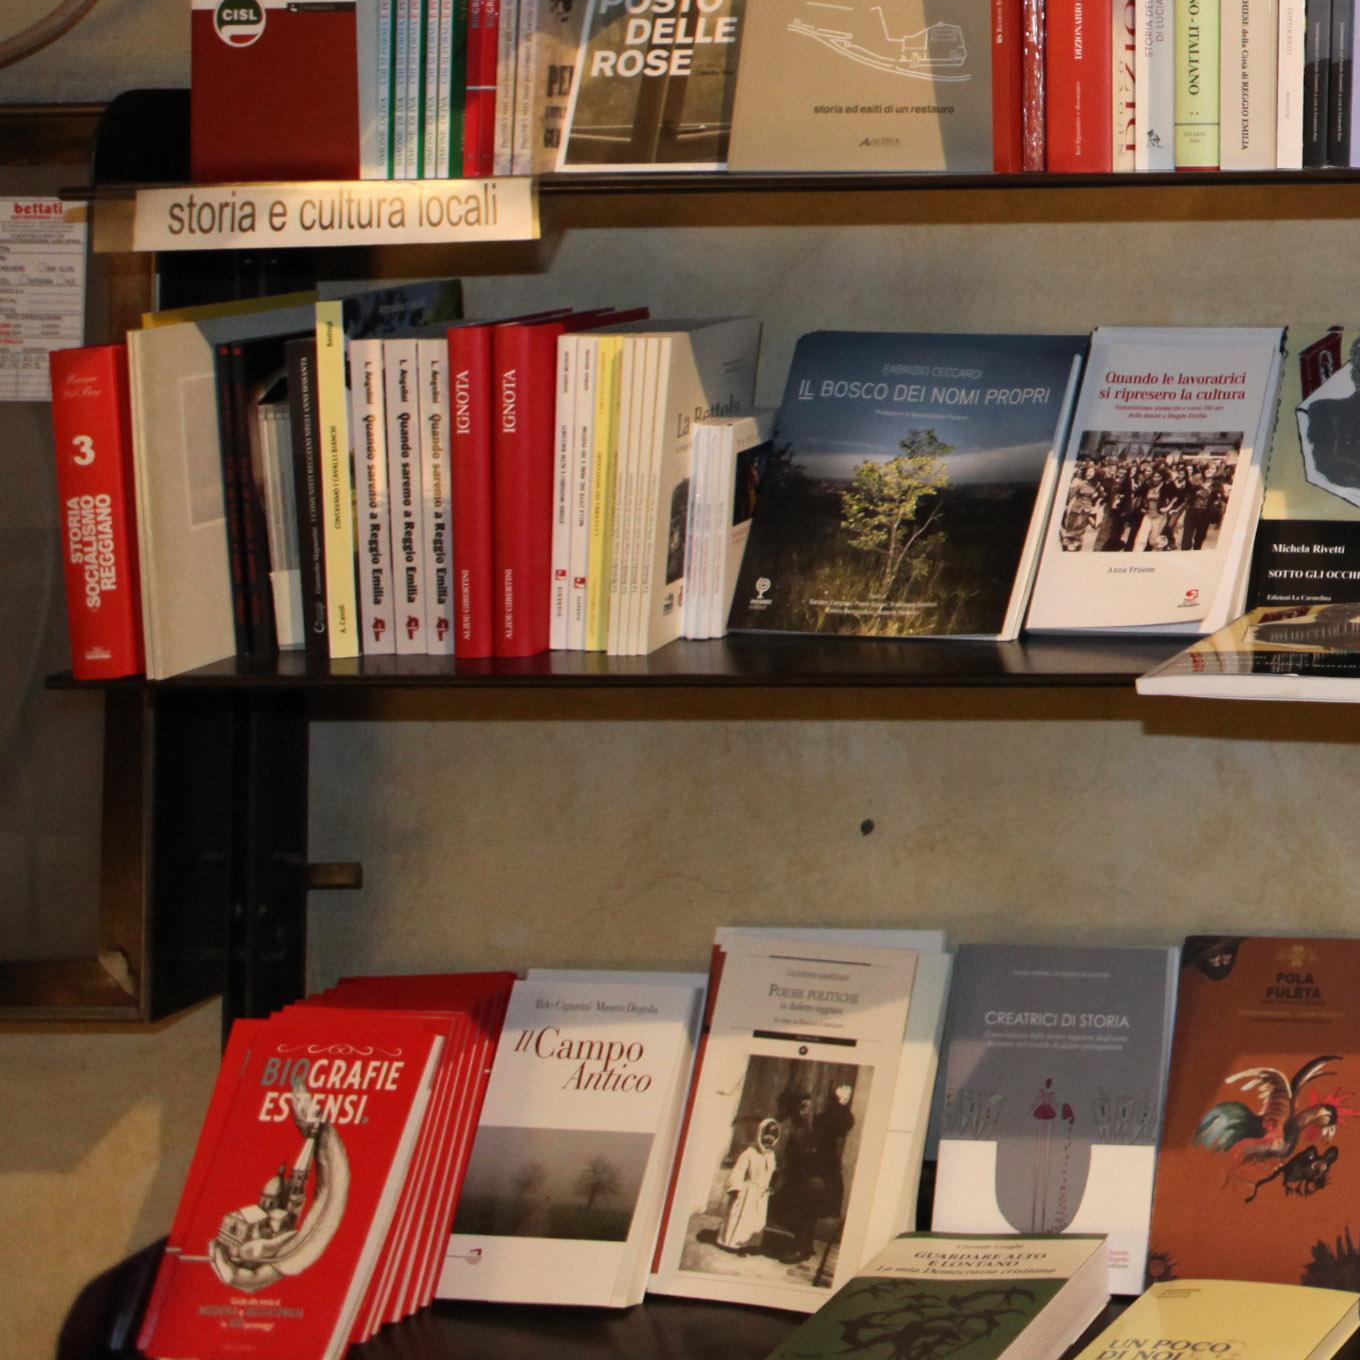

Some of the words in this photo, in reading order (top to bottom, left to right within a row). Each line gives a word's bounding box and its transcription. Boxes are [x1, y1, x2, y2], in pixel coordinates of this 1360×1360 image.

[222, 9, 258, 21] CISL
[625, 17, 738, 45] DELLE
[1074, 3, 1083, 60] DIZIONARIO
[1145, 20, 1153, 58] STORIA
[1156, 31, 1164, 42] DI
[1242, 28, 1250, 48] della
[591, 49, 693, 77] ROSE
[1188, 26, 1200, 96] ITALIANO
[1242, 71, 1250, 80] di
[813, 104, 843, 114] storia
[845, 104, 859, 114] ed
[860, 104, 881, 114] esiti
[883, 104, 893, 114] di
[895, 106, 908, 114] un
[910, 104, 954, 114] restauro
[1242, 82, 1250, 116] REGGIO
[1242, 118, 1250, 151] EMILIA
[14, 202, 63, 216] bettati
[168, 192, 256, 235] storia
[268, 205, 288, 231] e
[300, 189, 406, 232] cultura
[417, 183, 498, 229] locali
[883, 363, 929, 377] FABRIZIO
[1105, 370, 1159, 384] Quando
[1162, 372, 1174, 384] le
[1178, 371, 1246, 385] lavoratrici
[456, 370, 470, 434] IGNOTA
[502, 369, 516, 433] IGNOTA
[799, 380, 815, 397] IL
[820, 379, 888, 400] BOSCO
[893, 384, 925, 403] DEI
[930, 387, 980, 405] NOMI
[984, 388, 1050, 405] PROPRI
[1099, 387, 1111, 399] si
[1114, 387, 1177, 402] ripresero
[1180, 388, 1192, 400] la
[1196, 388, 1245, 400] cultura
[72, 435, 96, 466] 3
[363, 415, 376, 460] Quando
[397, 413, 411, 458] Quando
[429, 414, 443, 459] Quando
[367, 464, 377, 508] saremo
[402, 462, 411, 506] saremo
[433, 464, 442, 507] saremo
[67, 496, 84, 564] STORIA
[96, 494, 117, 591] REGGIANO
[368, 524, 382, 564] Reggio
[402, 522, 416, 562] Reggio
[433, 523, 446, 564] Reggio
[80, 495, 101, 608] SOCIALISMO
[1272, 544, 1310, 553] Michela
[1313, 544, 1345, 554] Rivetti
[372, 568, 384, 605] Emilia
[406, 566, 417, 603] Emilia
[436, 568, 448, 604] Emilia
[461, 570, 470, 613] GIBERTINI
[505, 568, 513, 611] GIBERTINI
[1268, 570, 1304, 579] SOTTO
[1305, 571, 1324, 579] GLI
[1326, 571, 1360, 580] OCCHI
[462, 615, 470, 640] ALIDE
[505, 613, 513, 639] ALIDE
[596, 1001, 625, 1011] Mauro
[984, 1010, 1058, 1026] CREATRICI
[1061, 1013, 1076, 1027] DI
[1079, 1013, 1130, 1029] STORIA
[514, 1030, 535, 1052] Il
[535, 1026, 644, 1072] Campo
[260, 1056, 405, 1091] BIOGRAFIE
[562, 1061, 652, 1093] Antico
[876, 1265, 893, 1273] La
[894, 1266, 919, 1274] mia
[914, 1251, 1000, 1260] GUARDARE
[1002, 1251, 1047, 1260] ALTO
[938, 1260, 1020, 1268] LONTANO
[1096, 1350, 1126, 1360] DI
[1130, 1350, 1181, 1360] NOI
[1108, 1339, 1150, 1349] UN
[1152, 1339, 1232, 1353] POCO
